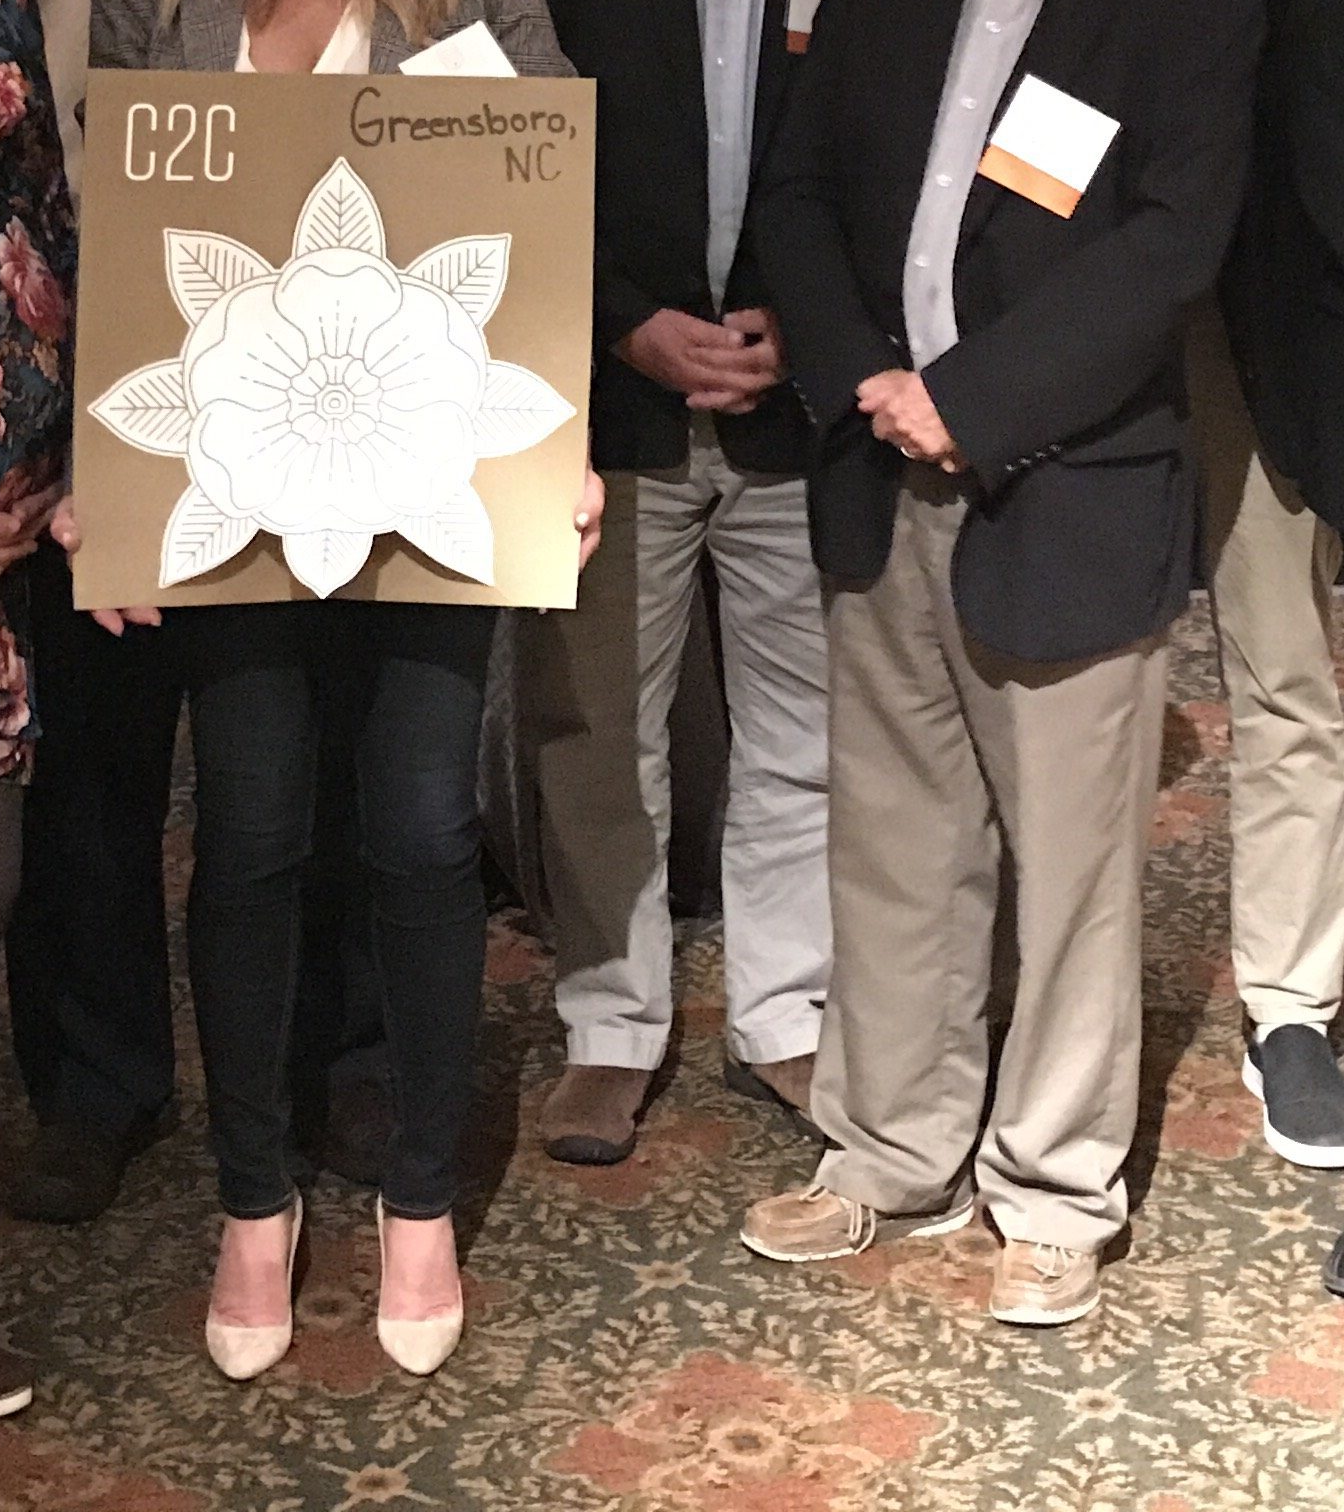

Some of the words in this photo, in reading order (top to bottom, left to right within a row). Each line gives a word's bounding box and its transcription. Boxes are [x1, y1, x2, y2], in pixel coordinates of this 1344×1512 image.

[125, 103, 236, 181] C2C
[350, 87, 577, 147] Greensboro,
[504, 142, 562, 183] NC
